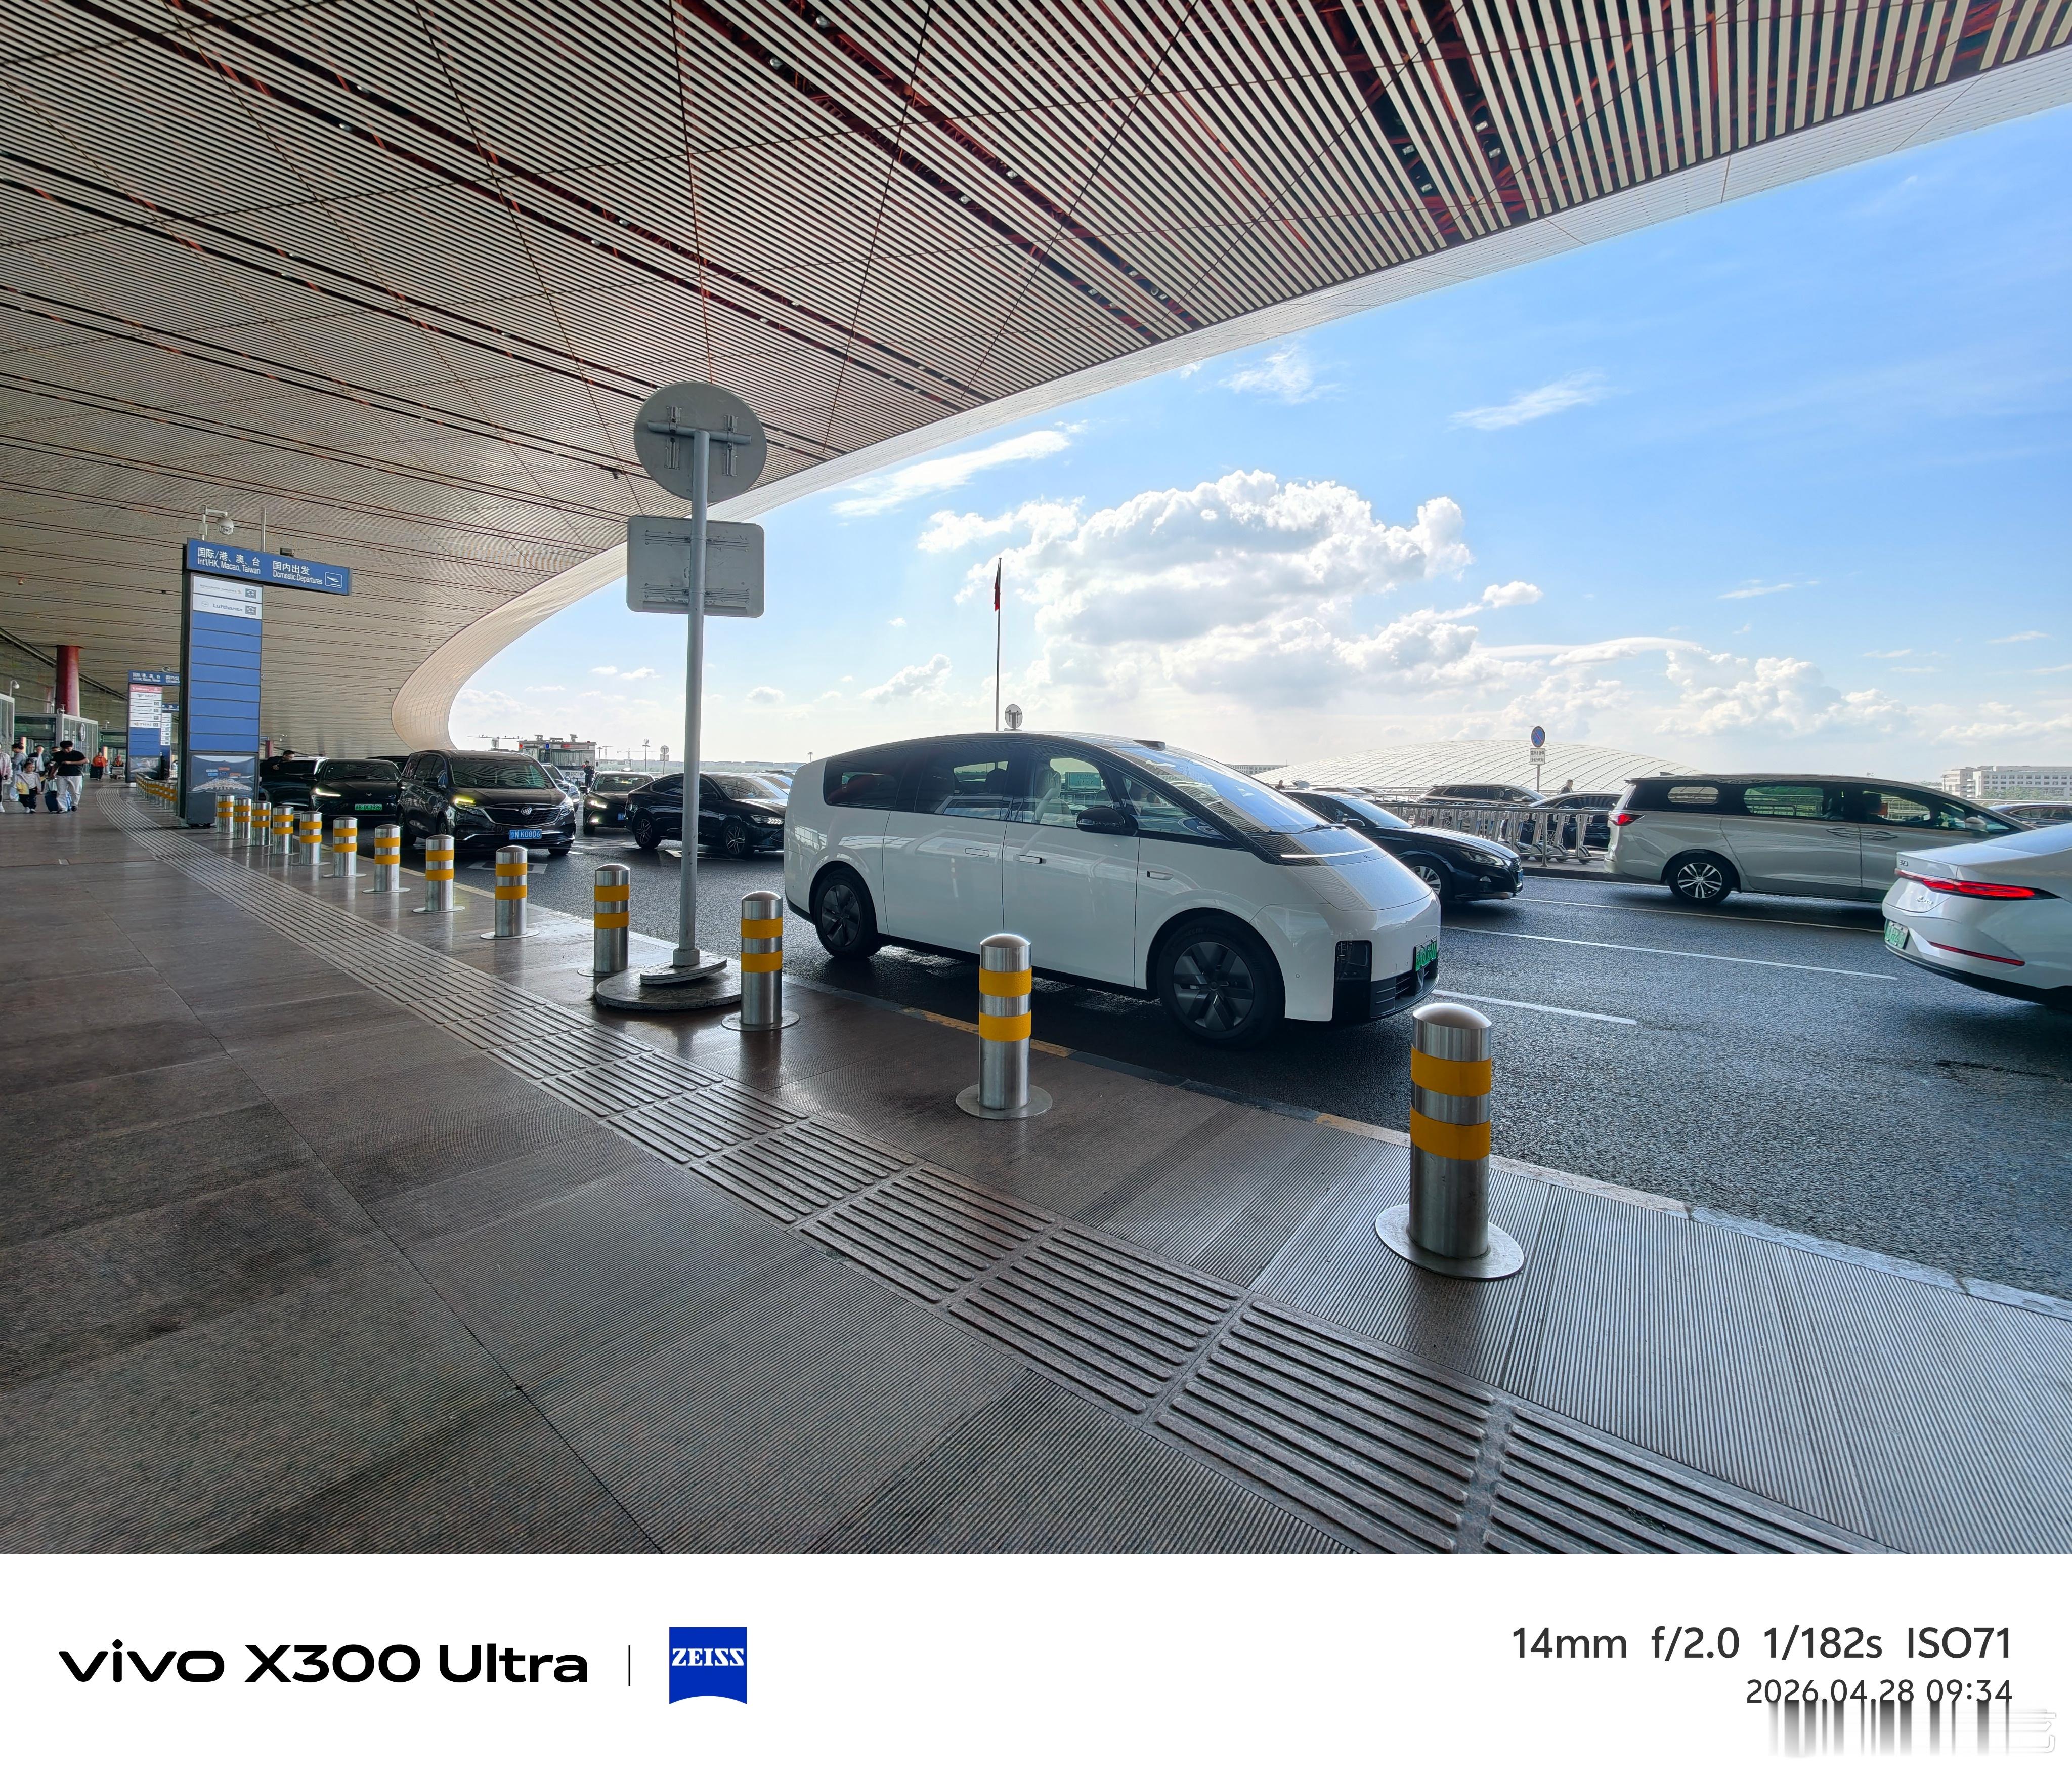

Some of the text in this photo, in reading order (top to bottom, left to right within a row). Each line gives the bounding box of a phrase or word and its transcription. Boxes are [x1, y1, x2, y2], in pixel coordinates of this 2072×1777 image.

[198, 547, 261, 567] 国际/港、澳、台
[221, 561, 241, 572] Macao,
[242, 564, 261, 575] Taiwan
[273, 561, 310, 576] 国内出发
[273, 570, 323, 585] Domestic Departures
[213, 603, 243, 612] Lufthansa
